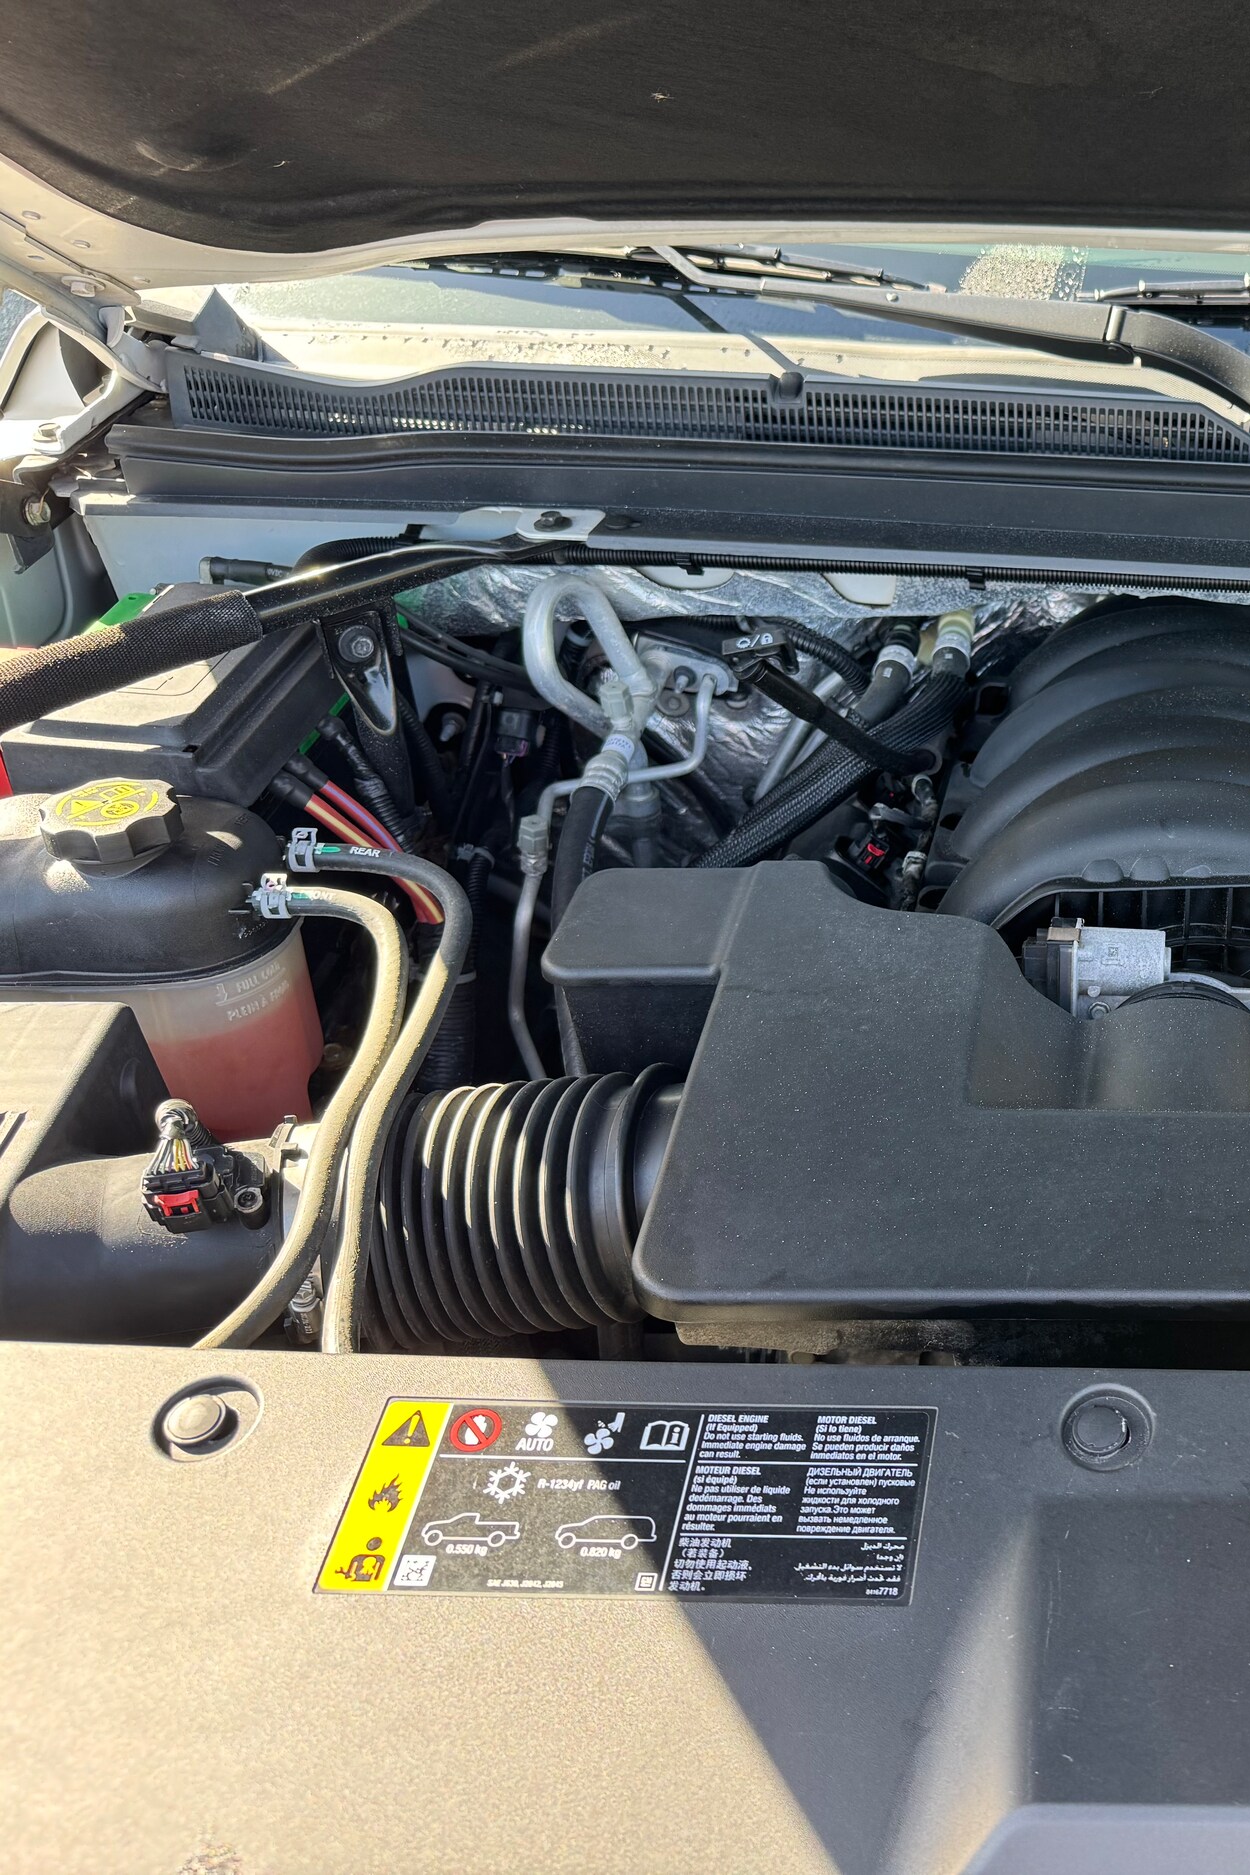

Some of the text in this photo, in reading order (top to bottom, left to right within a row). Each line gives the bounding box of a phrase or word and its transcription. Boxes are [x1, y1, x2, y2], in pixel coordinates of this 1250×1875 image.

[349, 846, 381, 858] REAR
[708, 1414, 769, 1424] DIESEL ENGINE
[817, 1416, 877, 1425] MOTOR DIESEL
[706, 1423, 758, 1433] (If Equipped)
[815, 1424, 862, 1434] (Si lo tiene)
[703, 1432, 715, 1440] Do
[716, 1432, 730, 1440] not
[747, 1433, 778, 1442] starting
[779, 1433, 804, 1441] fluids.
[814, 1434, 825, 1442] No
[843, 1434, 870, 1442] fluidos
[871, 1434, 882, 1442] de
[882, 1435, 920, 1444] arranque.
[515, 1438, 554, 1452] AUTO
[701, 1441, 806, 1452] Immediate engine damage
[812, 1442, 915, 1452] Se pueden producir daños
[715, 1450, 741, 1458] result.
[810, 1451, 854, 1460] inmediatos
[867, 1452, 876, 1460] el
[877, 1452, 902, 1460] motor.
[695, 1466, 761, 1475] MOTEUR DIESEL
[806, 1467, 913, 1478] ДИЗЕЛЬНЫЙ ДВИГАТЕЛЬ
[693, 1475, 738, 1485] (si équipé)
[805, 1478, 915, 1488] (если установлен) пусковые
[537, 1479, 621, 1492] R-1234yf PAG oil
[691, 1484, 791, 1495] Ne pas utiliser de liquide
[804, 1486, 867, 1496] Не используйте
[746, 1494, 763, 1503] Des
[801, 1497, 900, 1505] жидкости для холодного
[686, 1503, 777, 1513] dommages immédiats
[684, 1513, 695, 1521] au
[696, 1513, 728, 1521] moteur
[727, 1514, 771, 1523] pourraient
[798, 1515, 888, 1524] вызвать немедленное
[681, 1522, 715, 1531] résulter.
[796, 1525, 896, 1534] повреждение двигателя.
[678, 1537, 732, 1548] 柴油发动机
[445, 1543, 488, 1557] 0.550 kg
[580, 1546, 622, 1559] 0.820 kg
[671, 1569, 747, 1581] 否则会立即损坏
